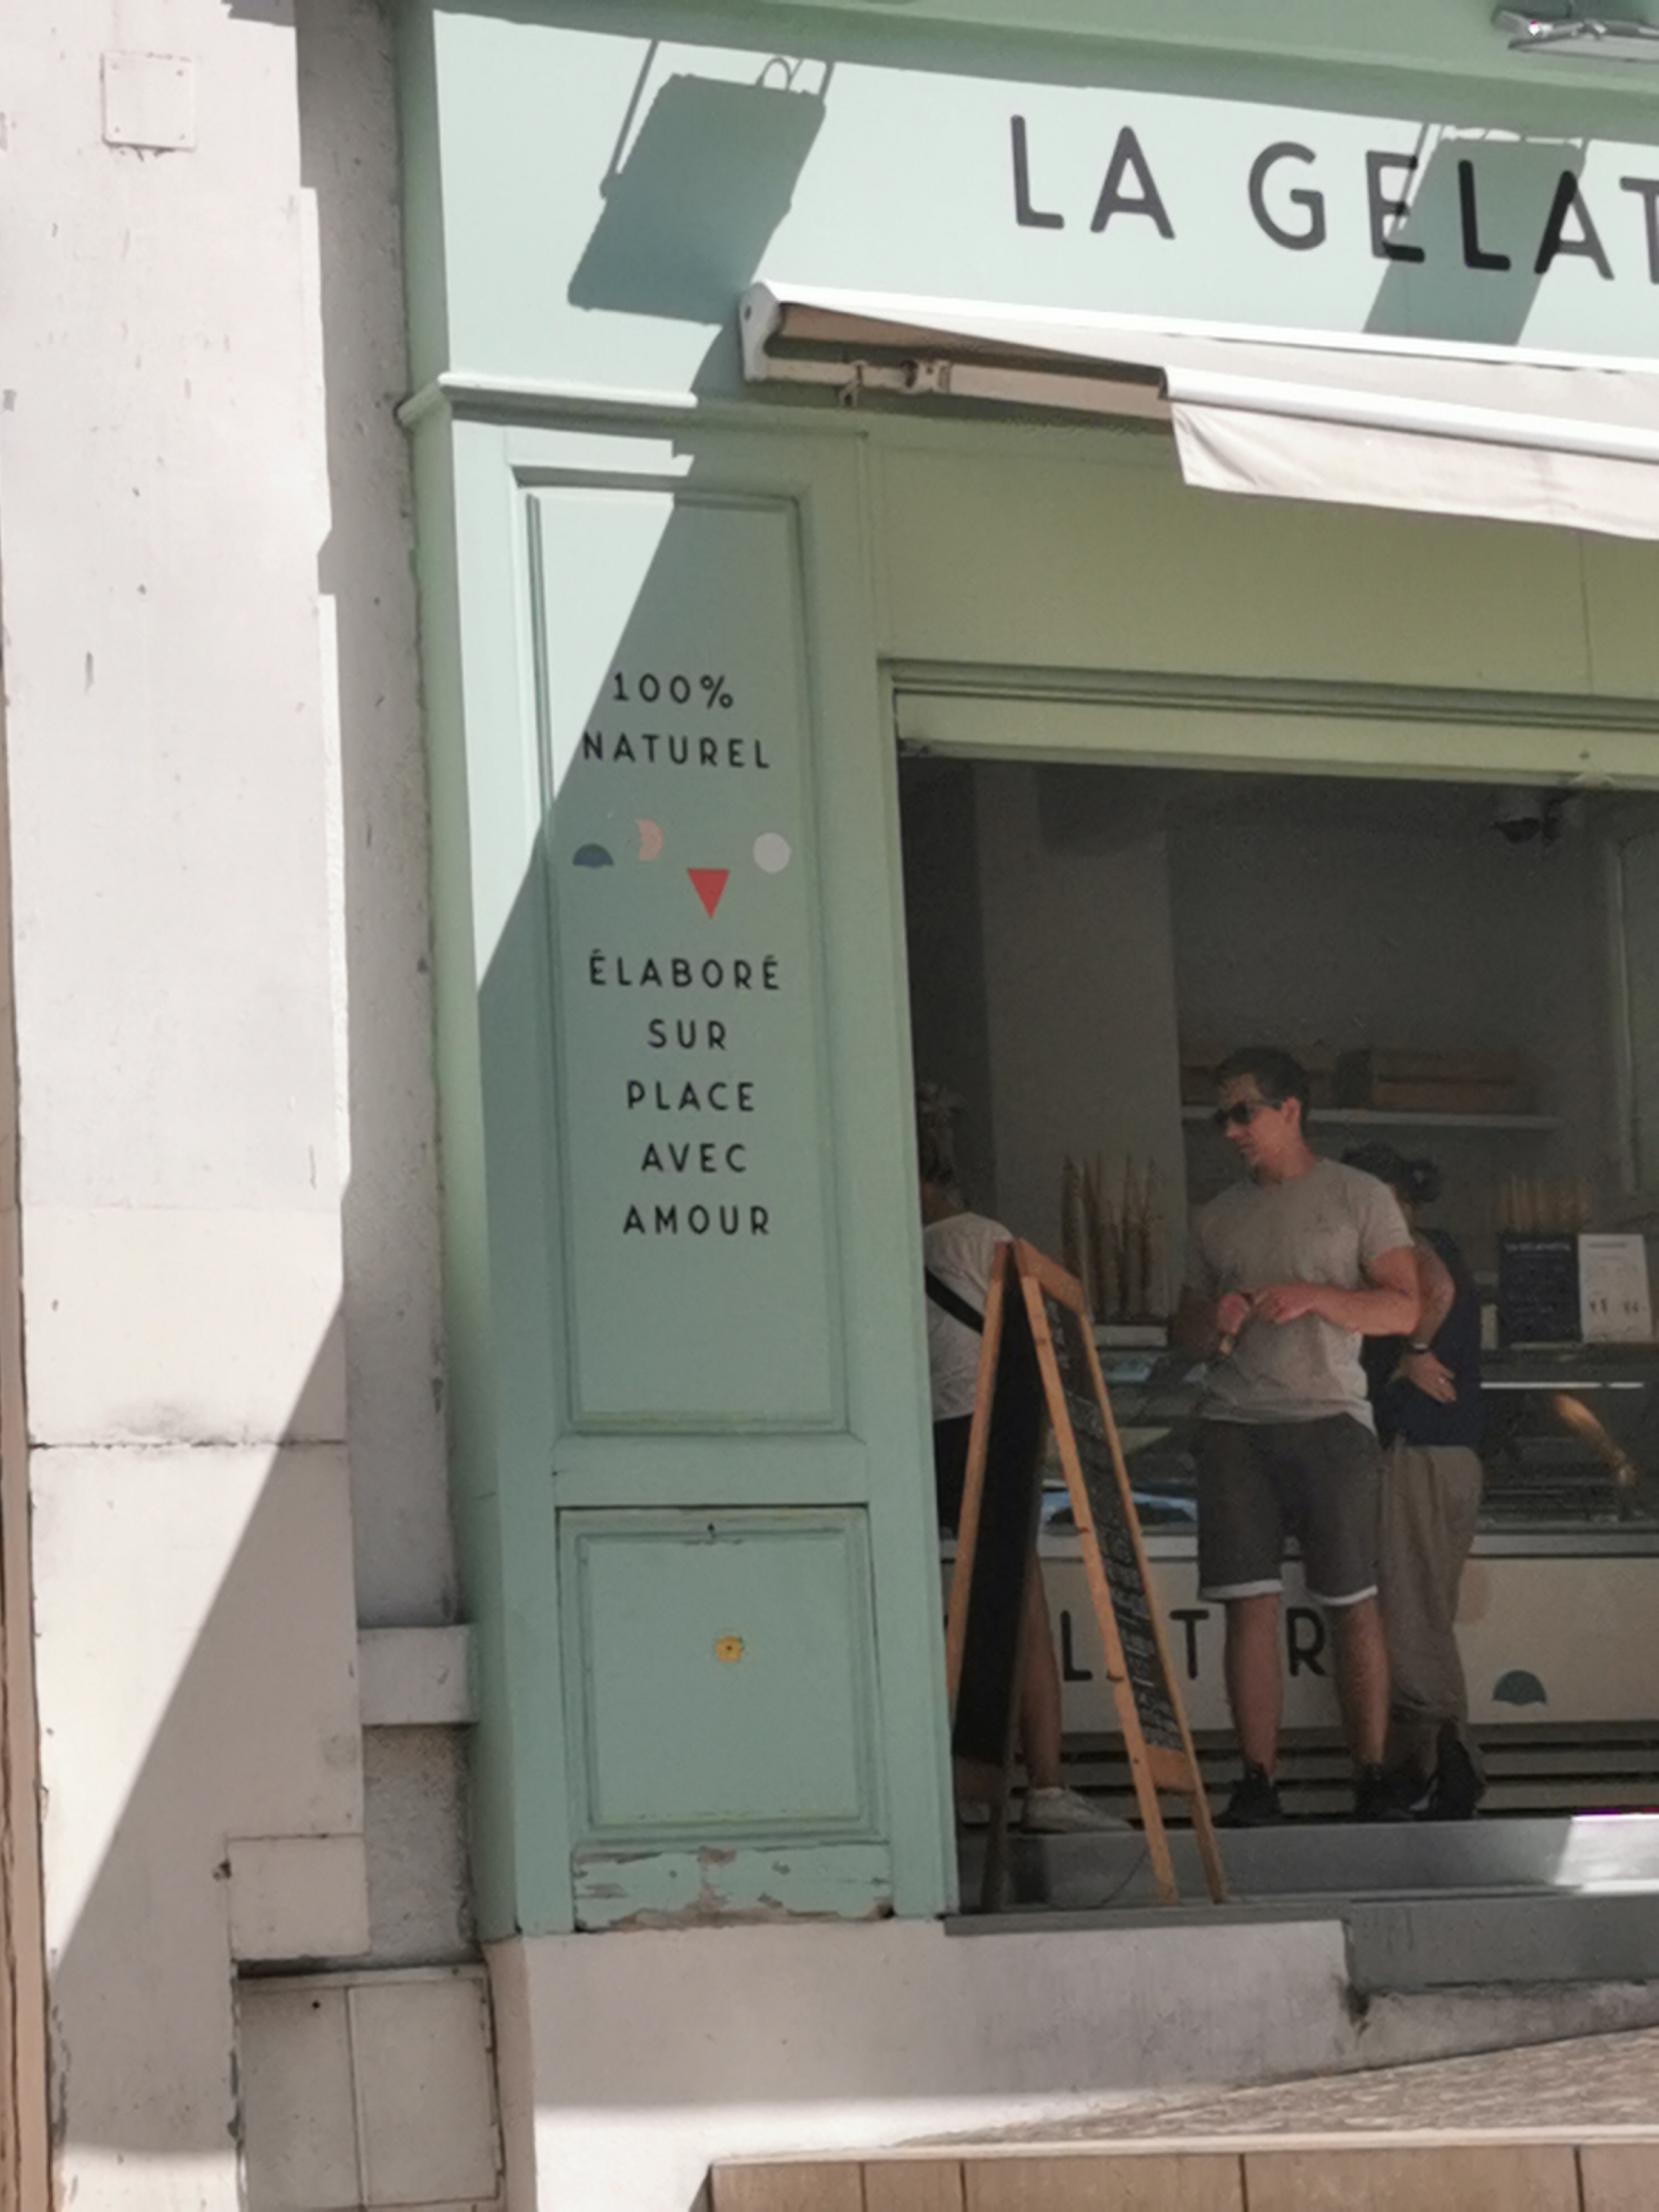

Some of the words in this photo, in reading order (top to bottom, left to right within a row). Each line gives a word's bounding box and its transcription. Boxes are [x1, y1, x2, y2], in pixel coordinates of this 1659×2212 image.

[1011, 115, 1175, 240] LA
[612, 671, 734, 709] 100%
[583, 730, 769, 769] NATUREL
[589, 948, 780, 990] ÉLABORÉ
[648, 1018, 726, 1050] SUR
[627, 1080, 755, 1112] PLACE
[641, 1142, 747, 1173] AVEC
[623, 1204, 769, 1235] AMOUR
